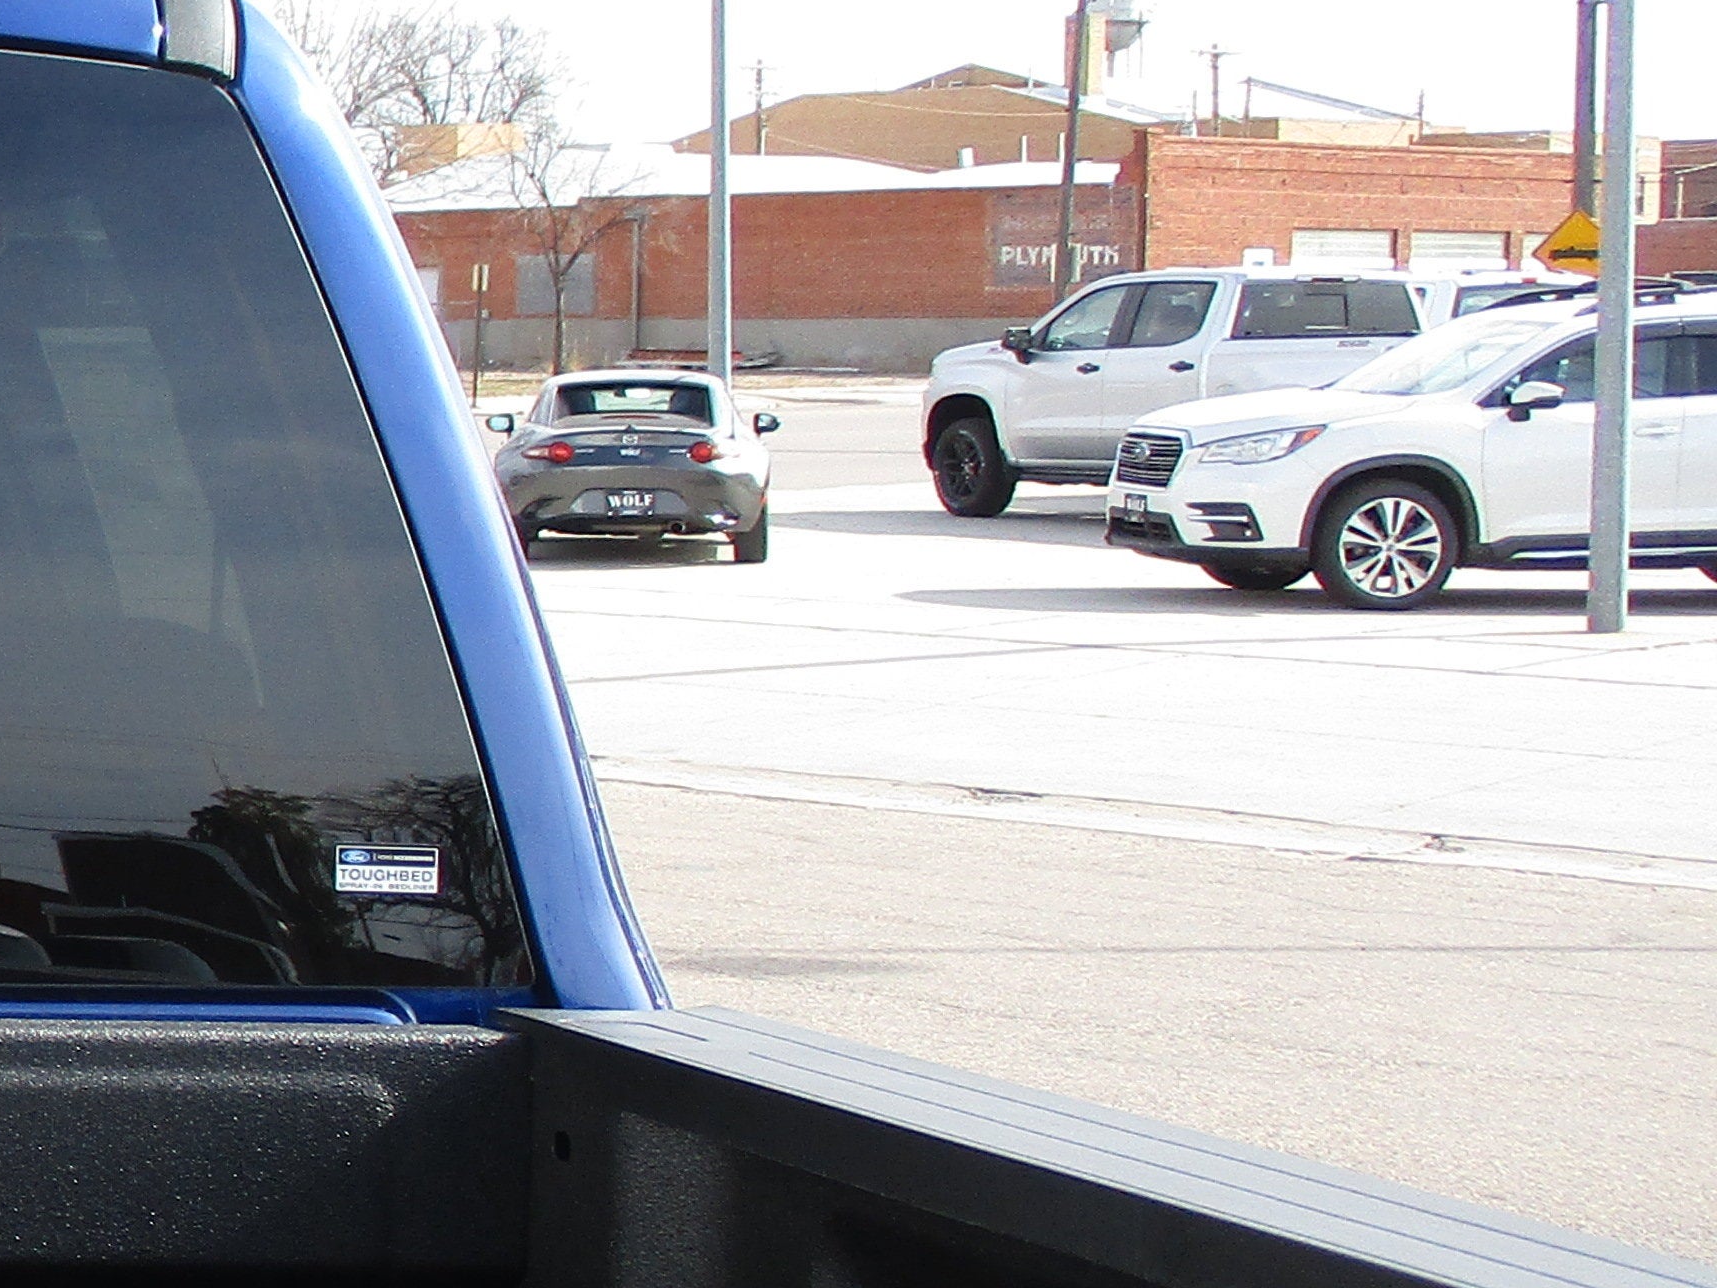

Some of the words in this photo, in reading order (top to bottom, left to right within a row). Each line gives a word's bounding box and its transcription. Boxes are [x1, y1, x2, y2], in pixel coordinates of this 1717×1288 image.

[1000, 245, 1120, 266] PLYMUTH
[606, 494, 654, 508] WOLF
[339, 868, 434, 882] TOUGHBED
